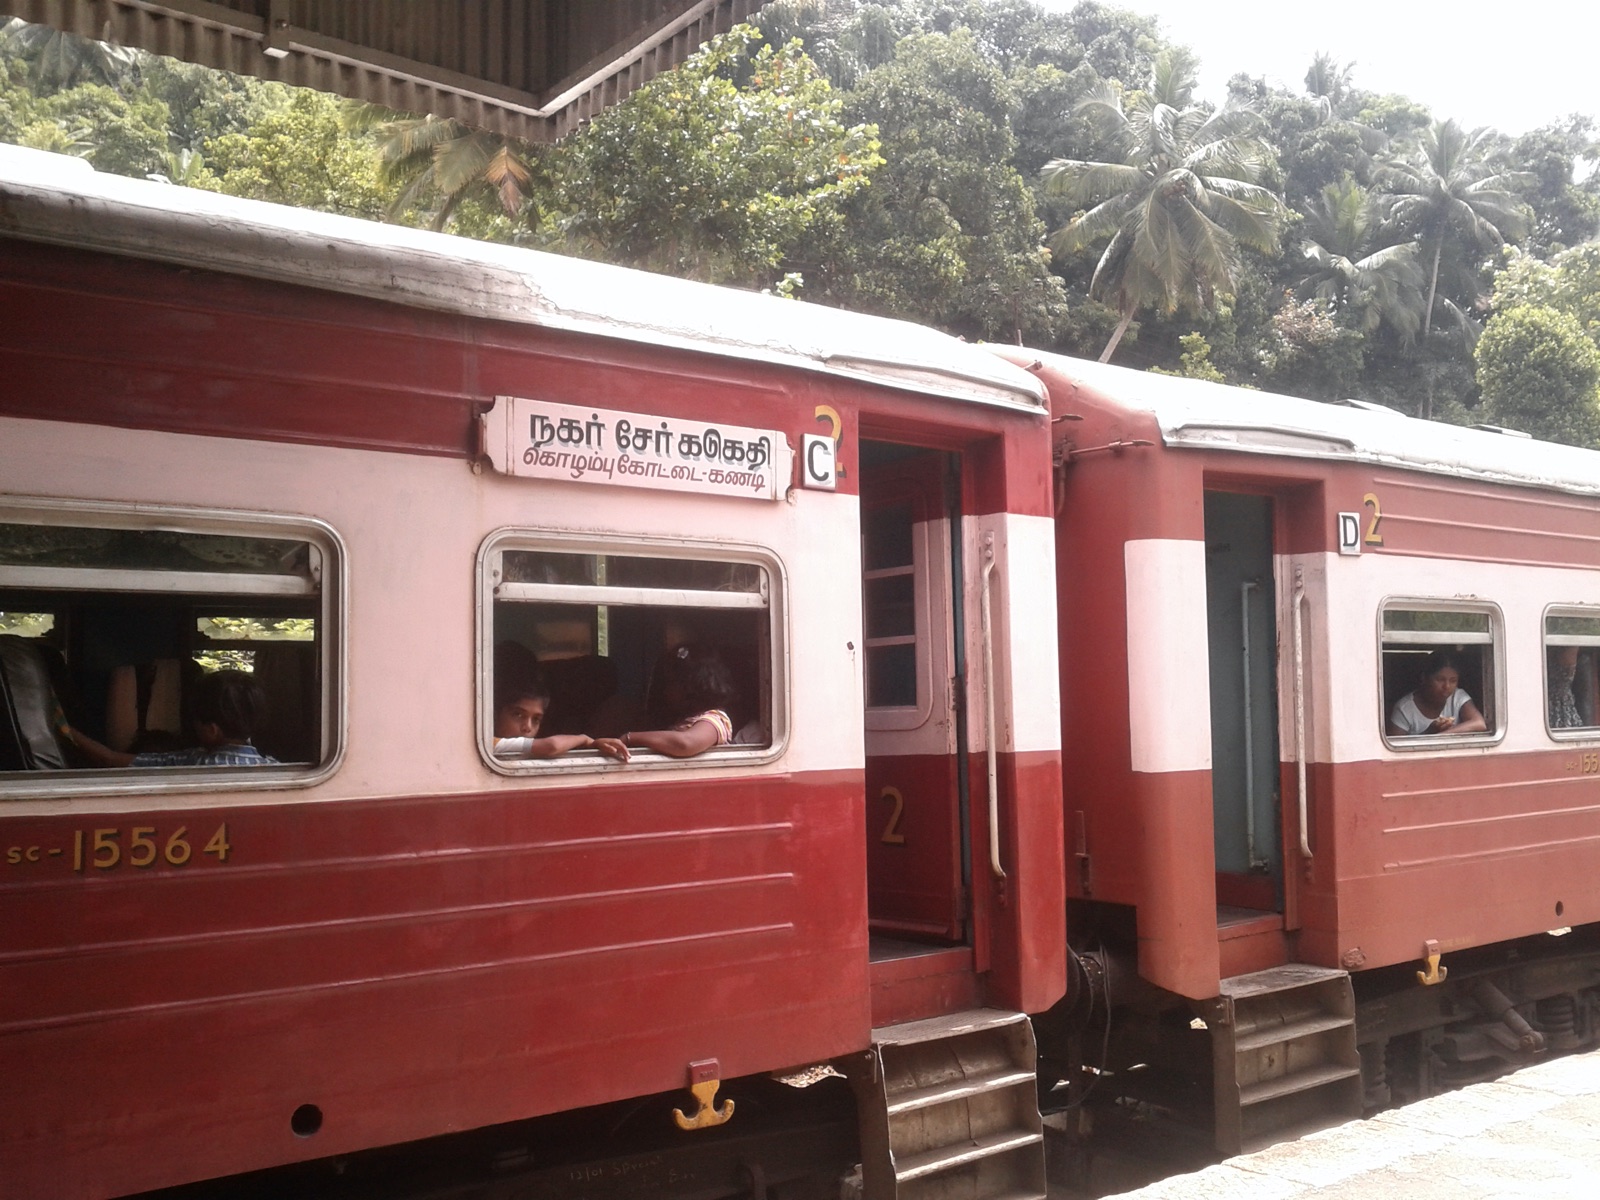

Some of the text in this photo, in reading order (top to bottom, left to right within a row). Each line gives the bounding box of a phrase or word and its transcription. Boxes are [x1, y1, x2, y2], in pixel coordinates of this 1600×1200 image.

[530, 413, 771, 471] நகர் சேர் கடுகதி
[807, 440, 830, 482] C
[1341, 515, 1359, 547] D
[1363, 492, 1384, 547] 2
[881, 785, 906, 846] 2
